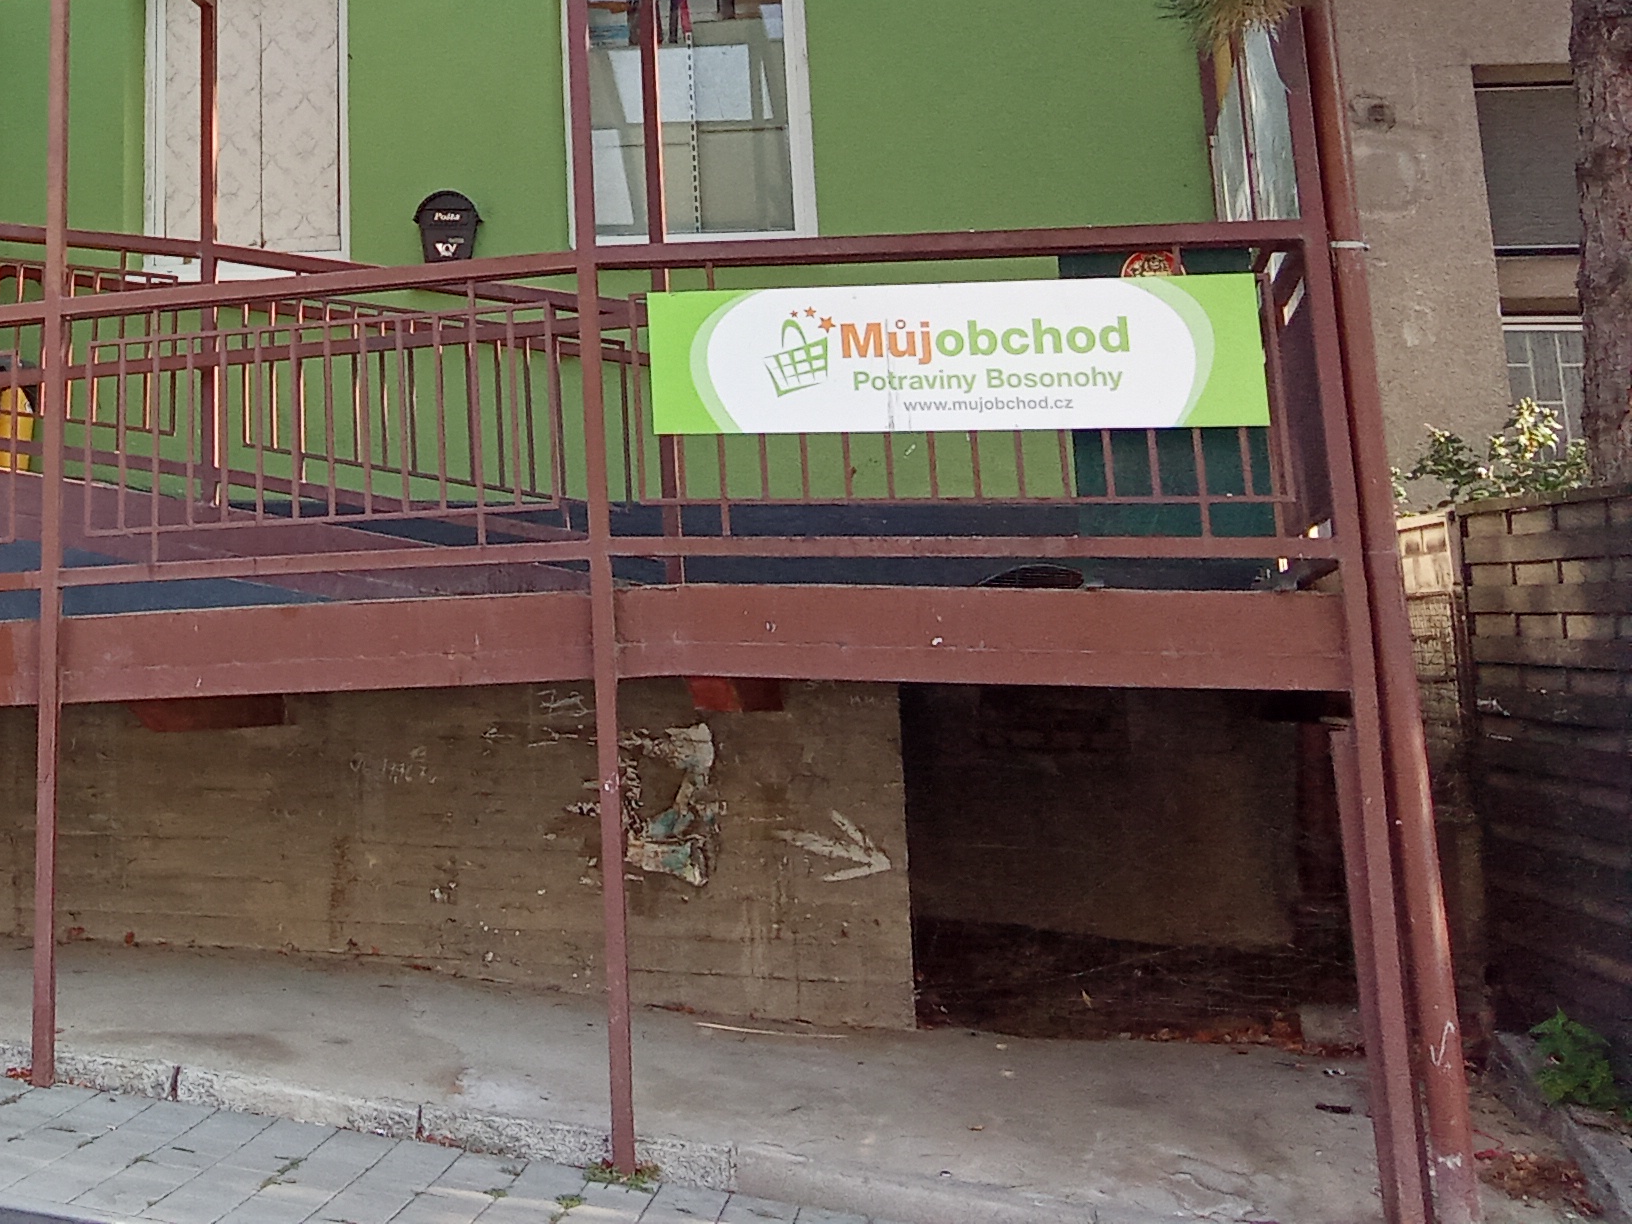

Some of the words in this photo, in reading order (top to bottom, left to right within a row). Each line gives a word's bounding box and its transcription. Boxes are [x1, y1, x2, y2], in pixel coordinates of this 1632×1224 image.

[840, 316, 1131, 365] Můjobchod
[853, 369, 977, 393] Potraviny
[985, 366, 1123, 391] Bosonohy
[903, 396, 1074, 413] www.mujobchod.cz
